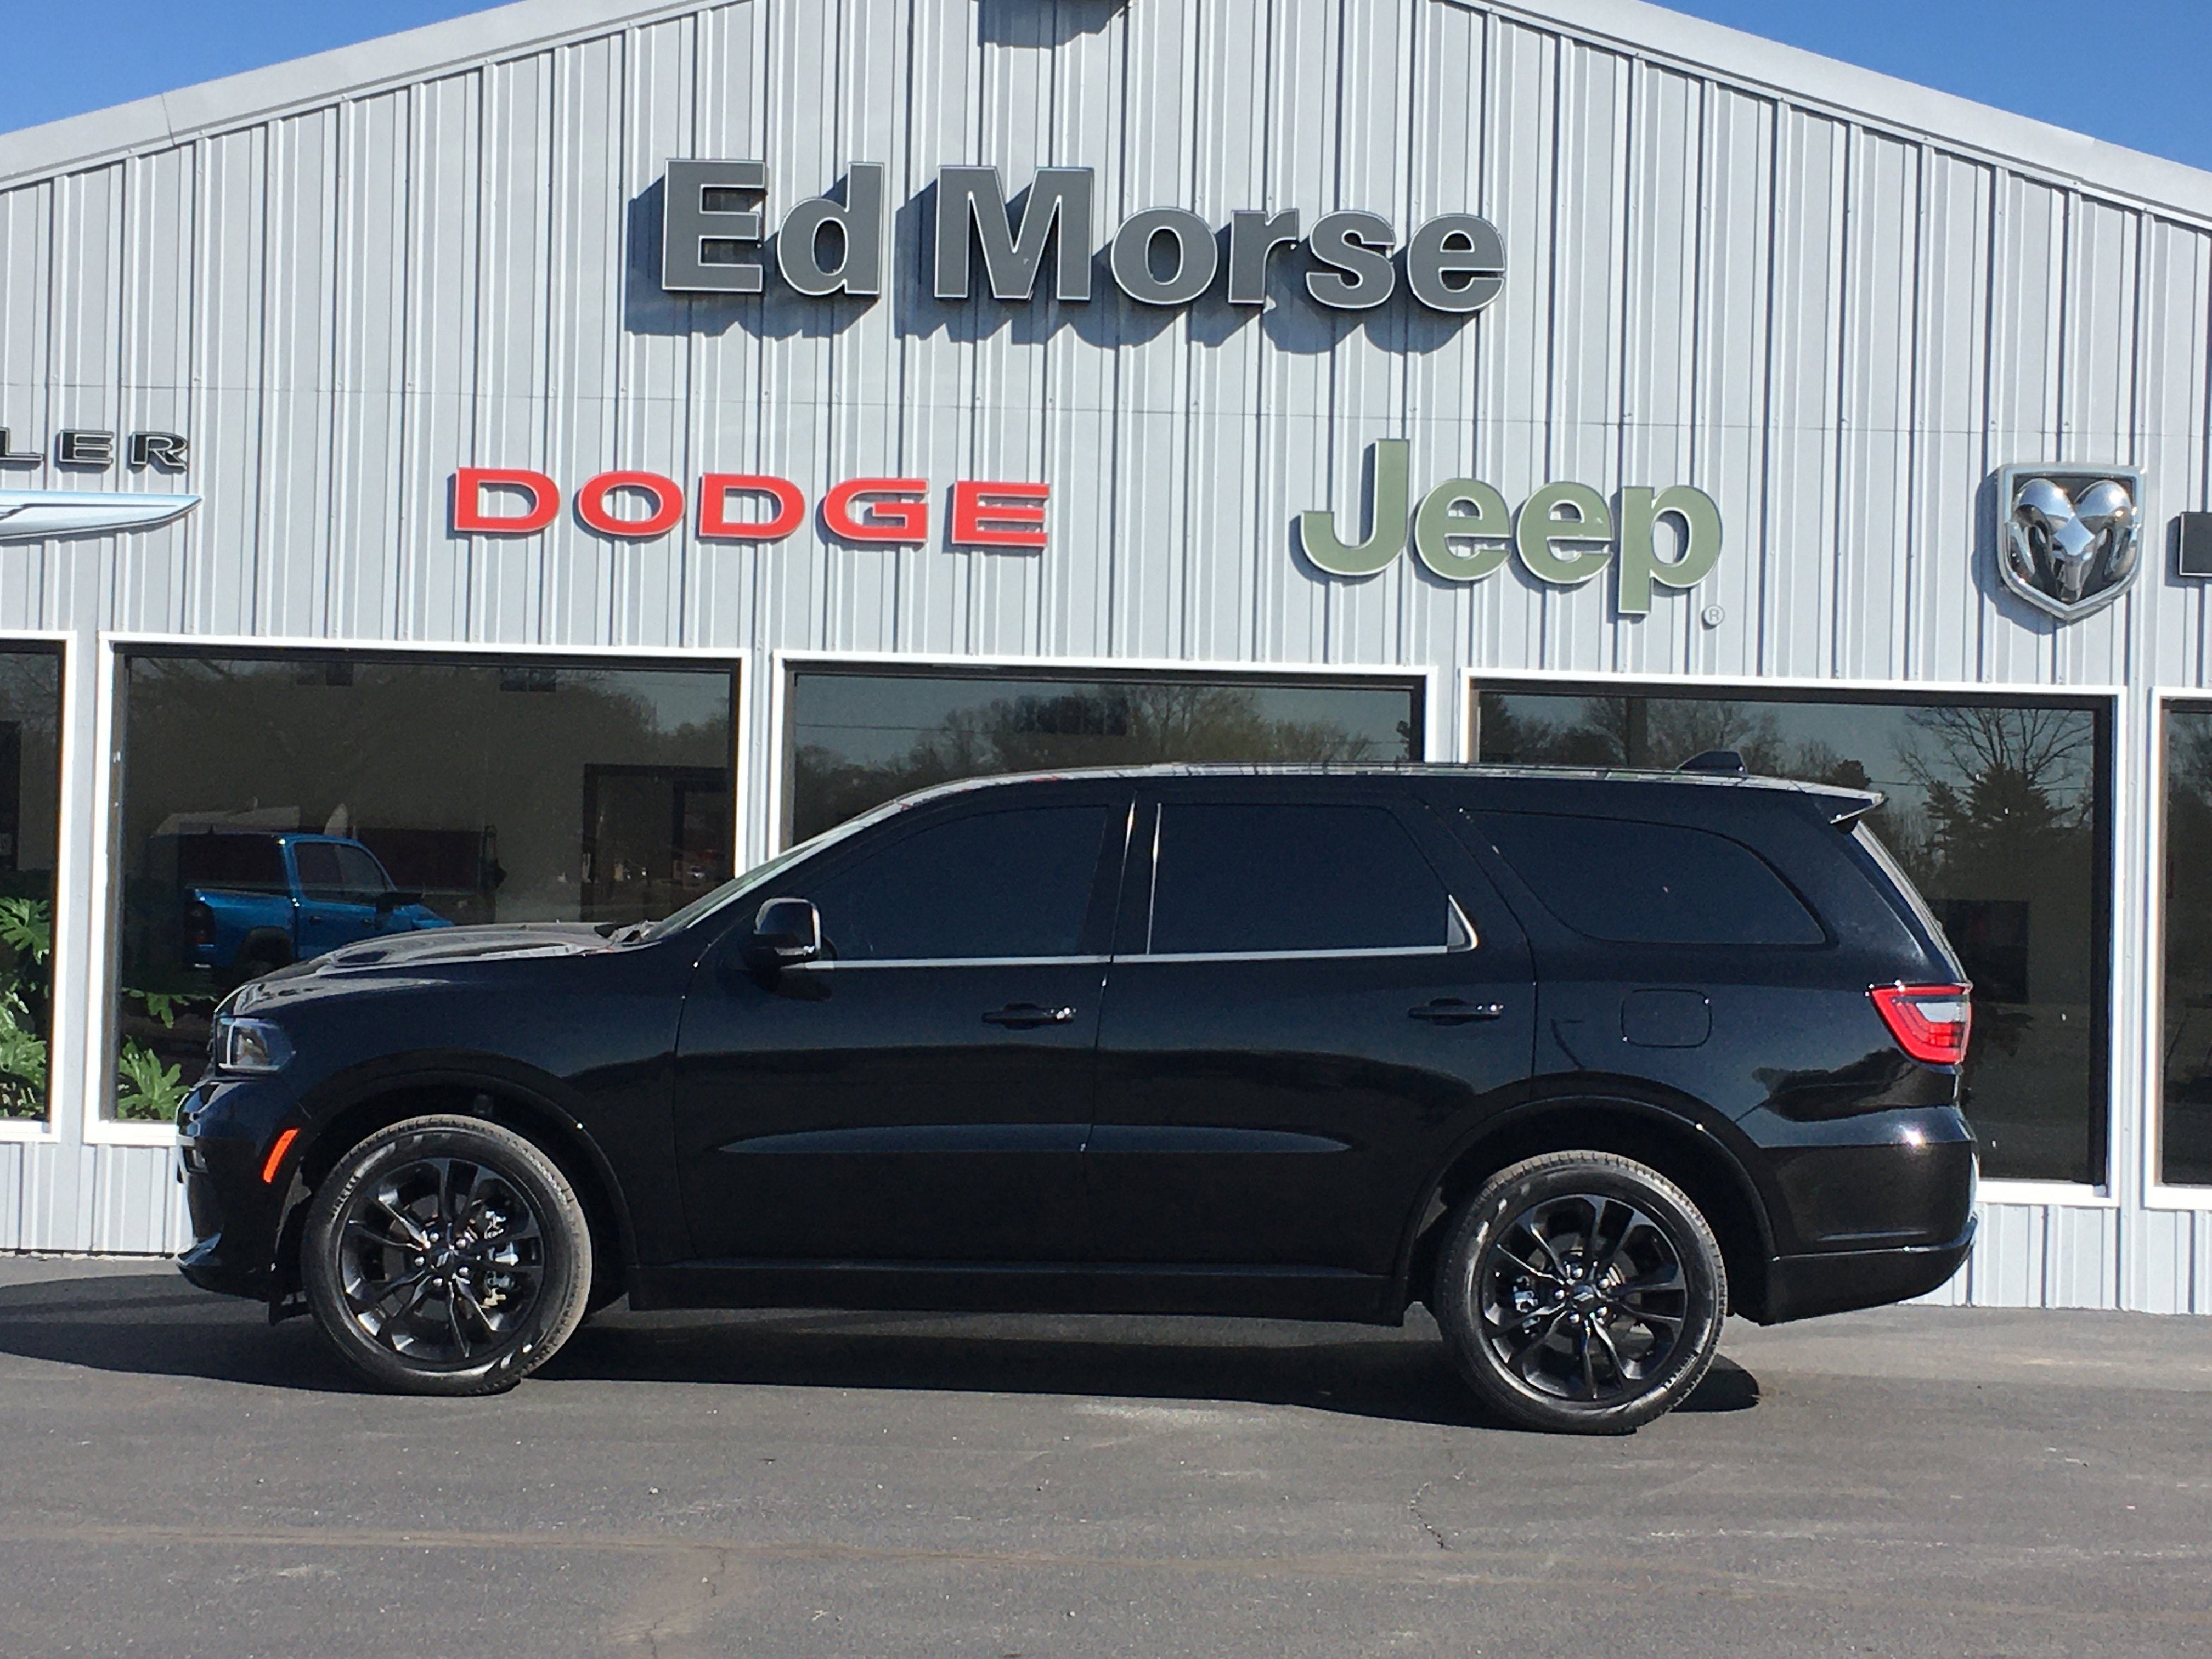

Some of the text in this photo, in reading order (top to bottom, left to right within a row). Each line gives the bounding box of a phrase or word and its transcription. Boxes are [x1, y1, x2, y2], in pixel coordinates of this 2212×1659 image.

[661, 157, 1508, 313] Ed Morse
[452, 466, 1051, 549] DODGE
[1300, 438, 1723, 614] Jeep
